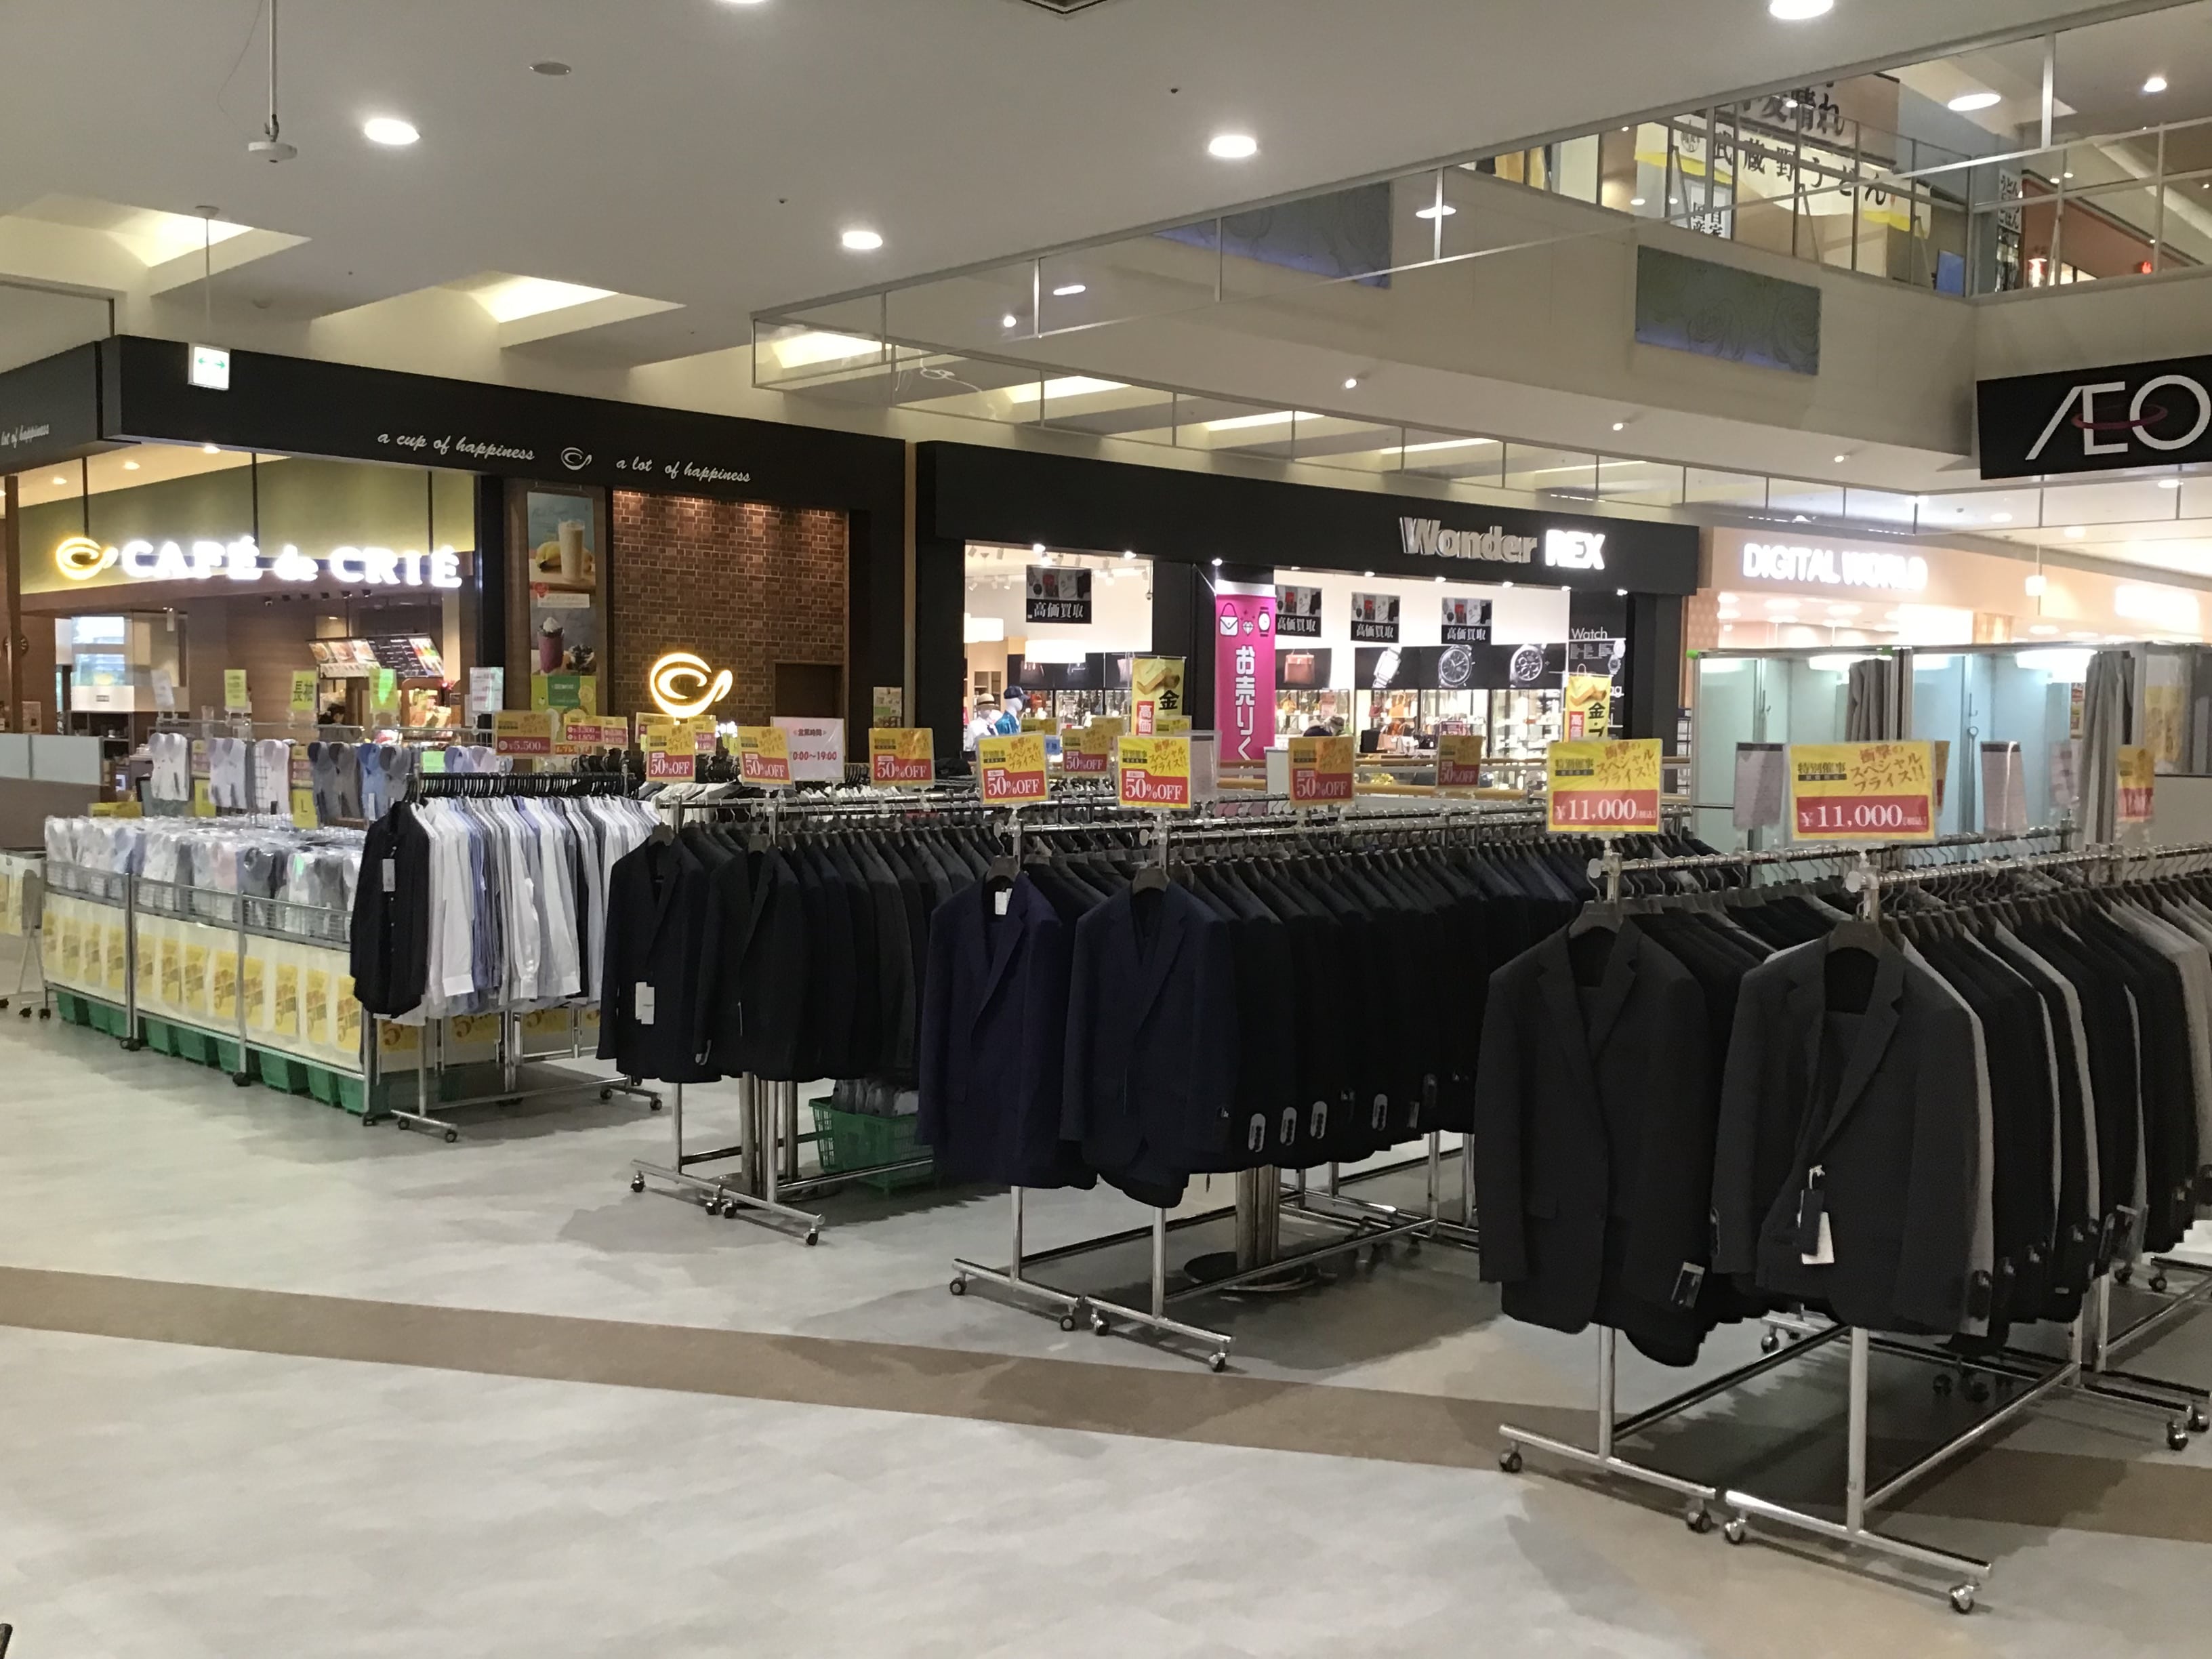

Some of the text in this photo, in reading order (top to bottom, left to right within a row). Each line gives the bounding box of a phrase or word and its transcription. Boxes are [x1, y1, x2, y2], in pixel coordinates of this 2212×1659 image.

[377, 434, 535, 460] a cup of happiness
[616, 456, 751, 483] a lot of happiness
[1399, 517, 1606, 570] Wonder REX
[121, 535, 264, 580] CAFÉ
[274, 544, 320, 581] &
[1743, 543, 1841, 584] DIGITAL
[1033, 601, 1084, 619] 高価買取
[1277, 616, 1316, 633] 高価買取
[1356, 623, 1394, 638] 高価買取
[1447, 627, 1486, 641] 高価買取
[1571, 626, 1608, 640] Watch
[1159, 689, 1180, 711] 金
[1235, 645, 1256, 779] お売りく
[651, 758, 691, 776] 50%OFF
[745, 759, 785, 777] 50%OFF
[878, 761, 927, 779] 50%OFF
[1065, 756, 1103, 771] 50%OFF
[1851, 753, 1921, 779] スペシャル
[987, 777, 1040, 796] 50%OFF
[1125, 779, 1183, 800] 50%OFF
[1296, 778, 1348, 798] 50%OFF
[1555, 798, 1637, 821] ¥11,000
[1800, 804, 1903, 827] ¥11,000
